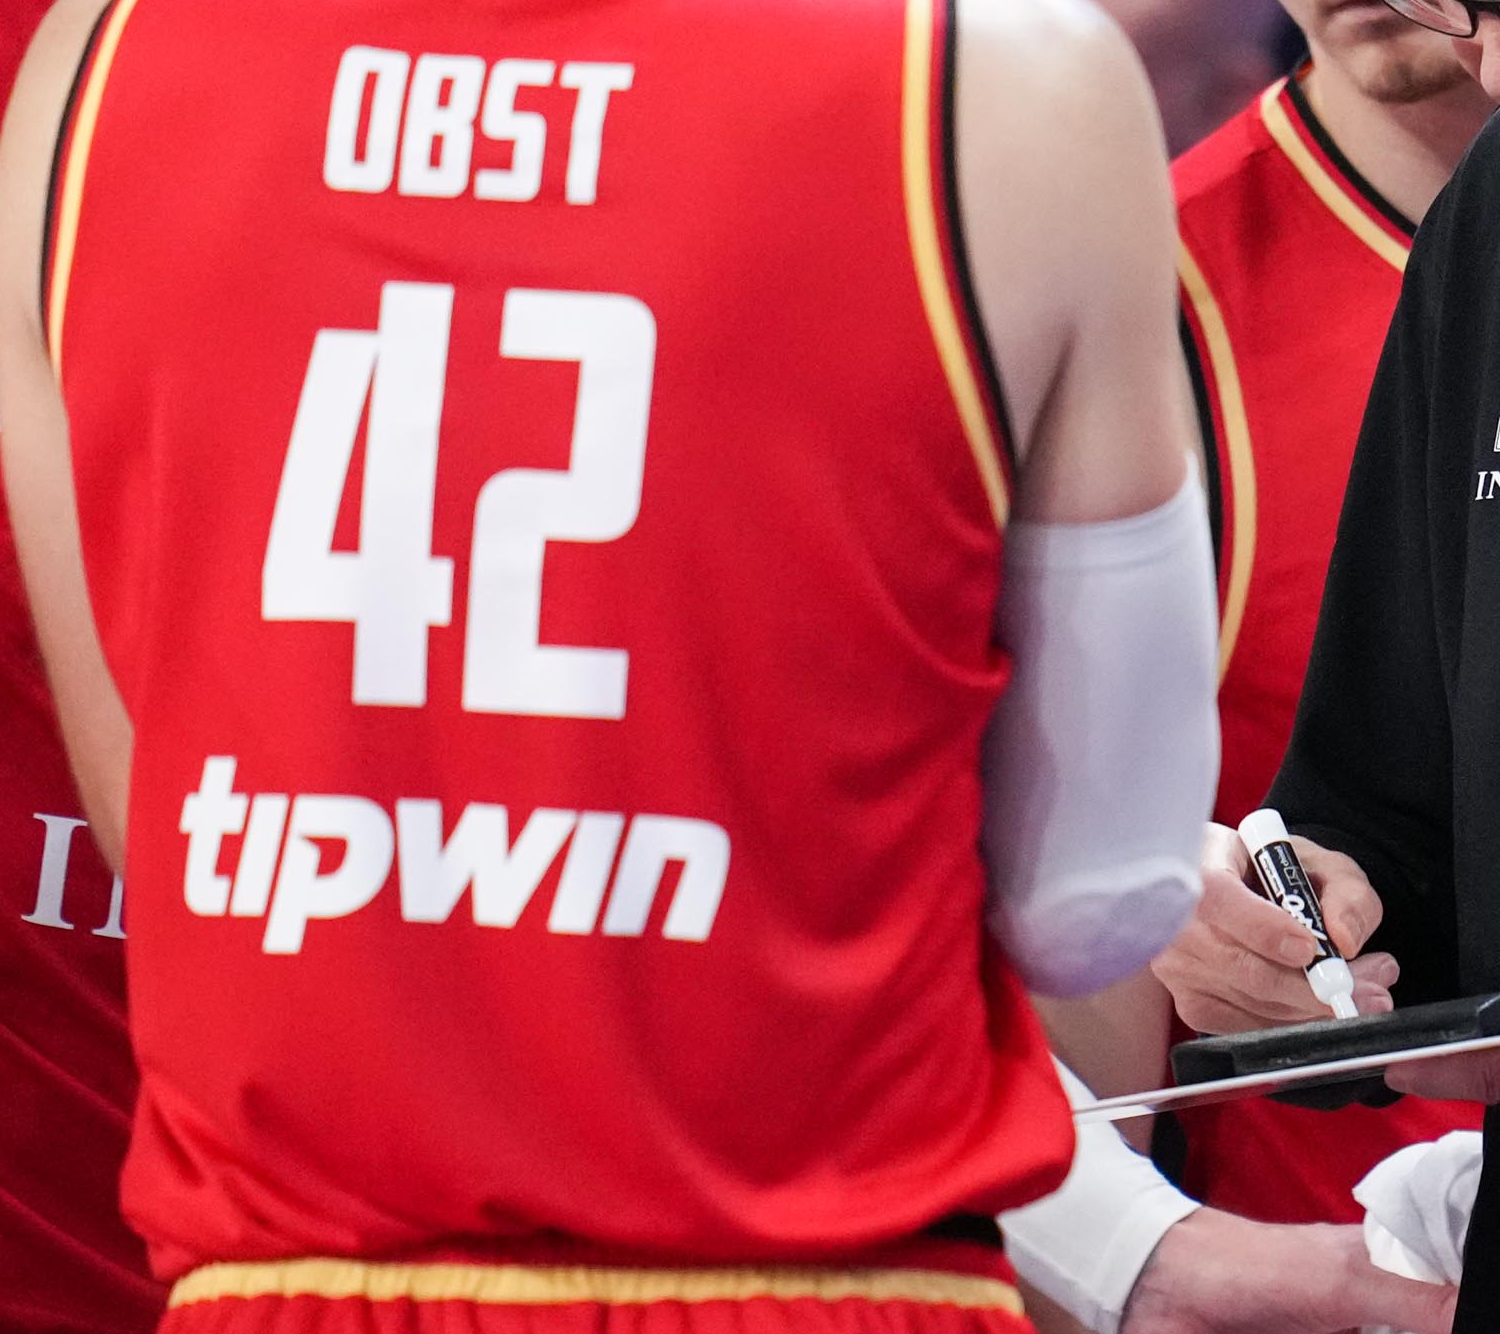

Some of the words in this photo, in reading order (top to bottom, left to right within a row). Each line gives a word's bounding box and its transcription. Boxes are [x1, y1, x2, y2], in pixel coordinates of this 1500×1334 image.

[323, 47, 634, 206] OBST
[261, 281, 657, 720] 42
[179, 756, 731, 956] tipwin
